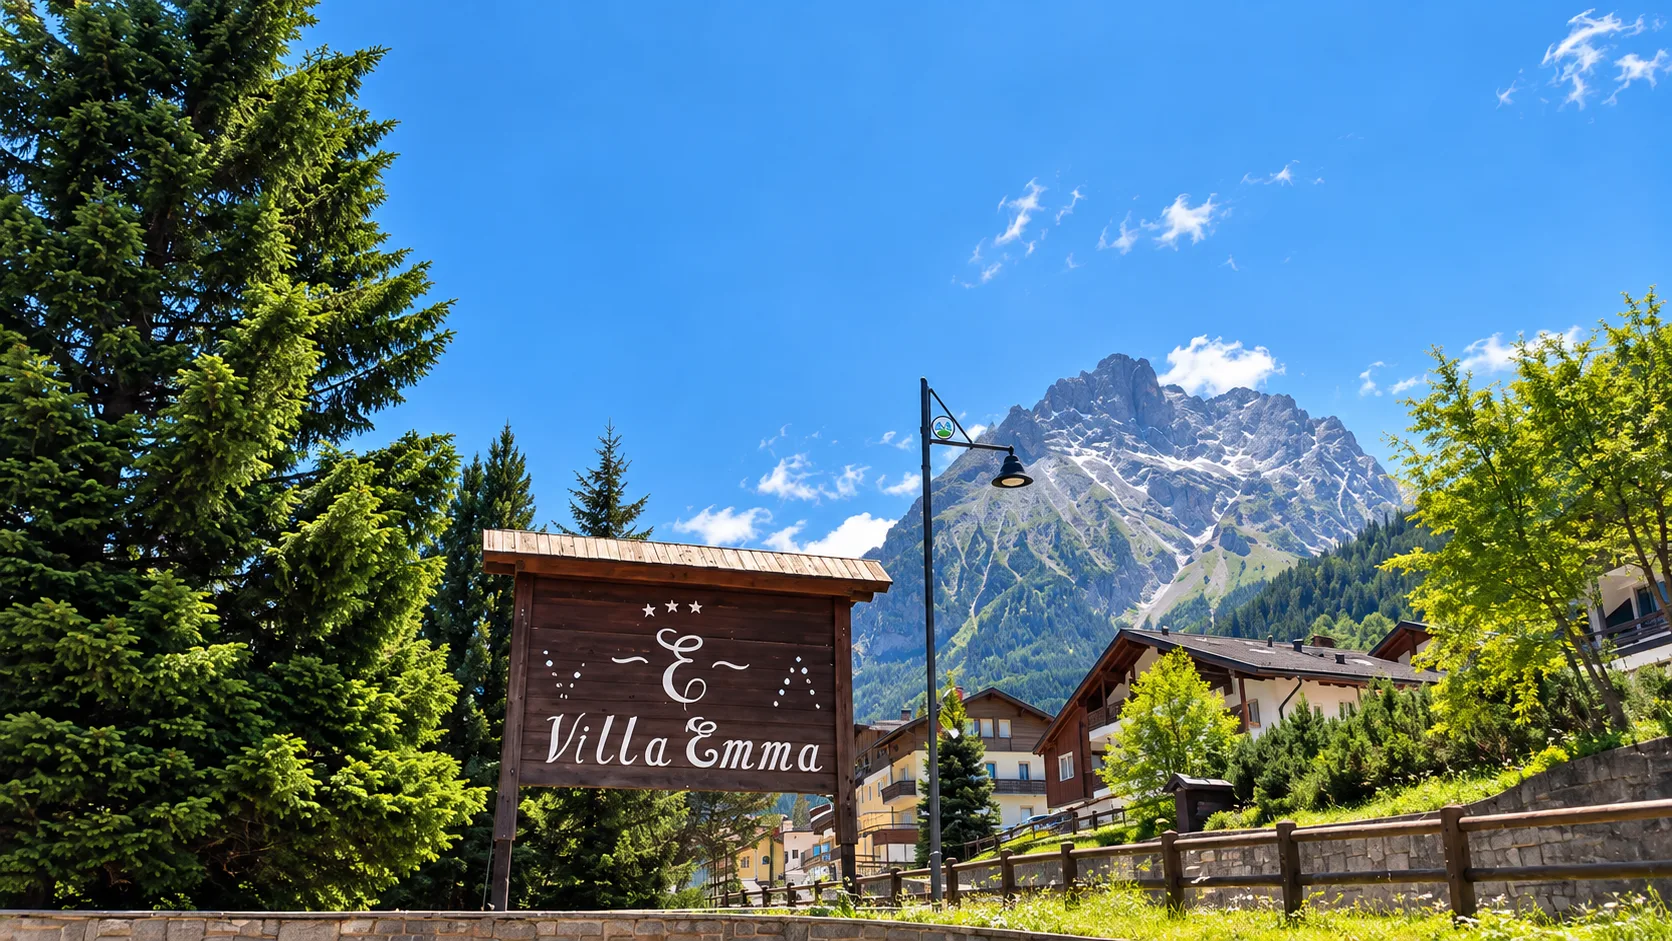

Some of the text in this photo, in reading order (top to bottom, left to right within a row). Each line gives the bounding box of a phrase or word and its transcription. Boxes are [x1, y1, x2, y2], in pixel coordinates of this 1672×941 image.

[656, 628, 707, 711] E
[546, 712, 823, 773] Villa Emma
